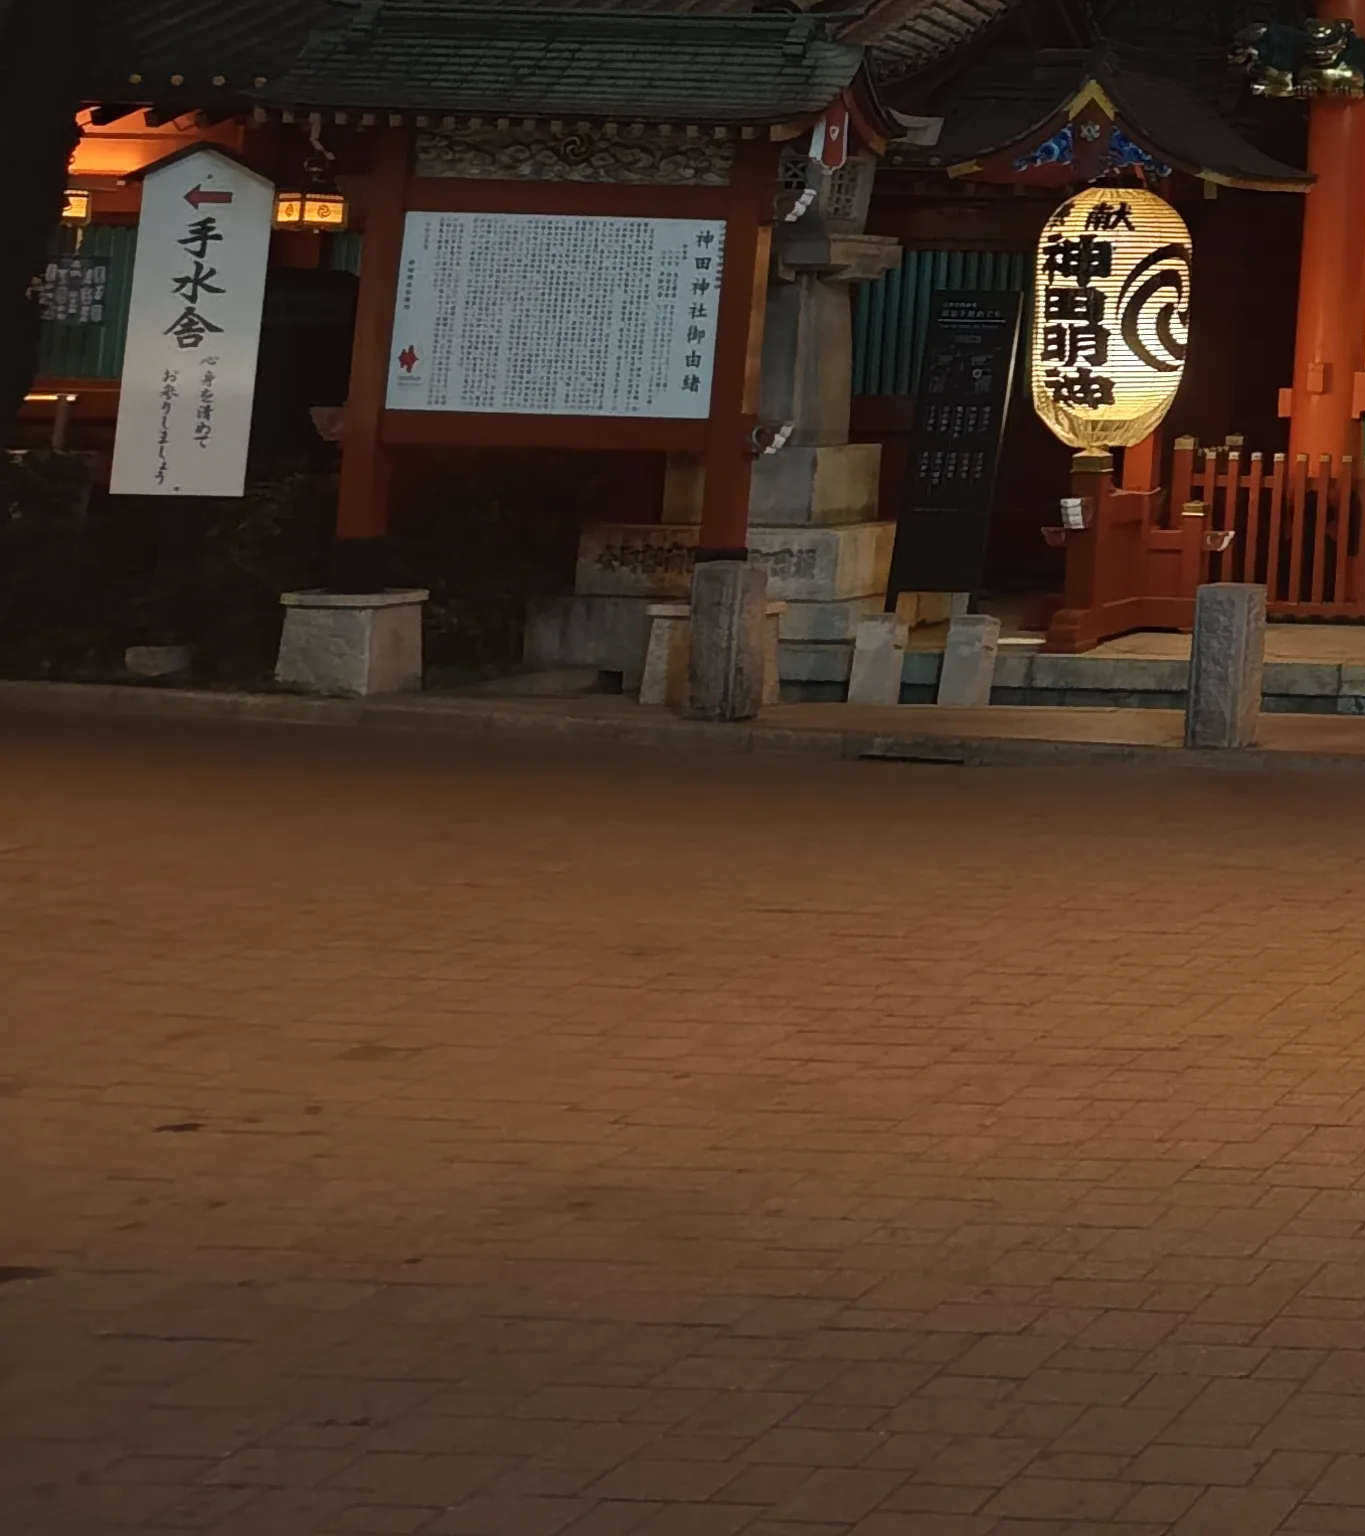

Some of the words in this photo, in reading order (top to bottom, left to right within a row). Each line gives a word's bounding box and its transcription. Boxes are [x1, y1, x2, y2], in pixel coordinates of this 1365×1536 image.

[163, 216, 226, 348] 手水舎
[682, 229, 715, 393] 神田神社御由緒
[1040, 234, 1116, 409] 神田明神
[155, 369, 180, 485] お参りしましょう
[193, 356, 220, 448] 心身を清めて
